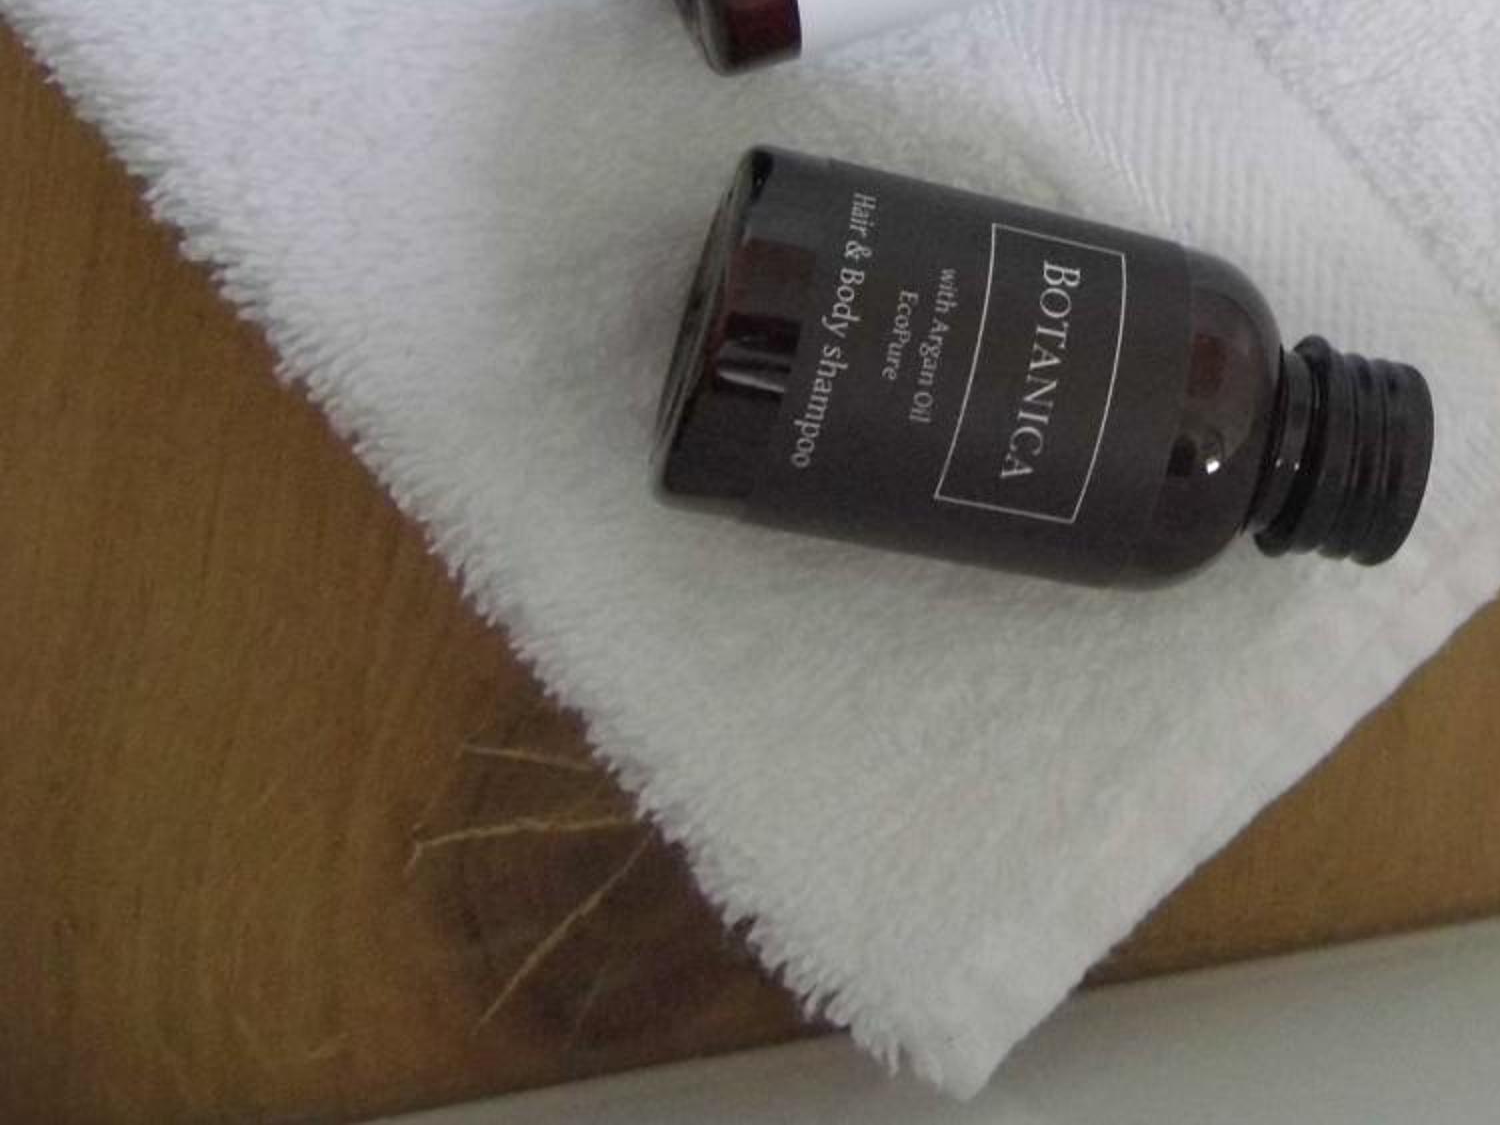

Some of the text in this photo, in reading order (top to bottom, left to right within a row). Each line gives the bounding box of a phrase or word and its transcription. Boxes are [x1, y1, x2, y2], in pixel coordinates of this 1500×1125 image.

[790, 192, 877, 468] Hair & Body shampoo
[881, 289, 919, 381] EcoPure
[909, 268, 959, 424] with Argan Oil
[1000, 259, 1082, 479] BOTANICA
